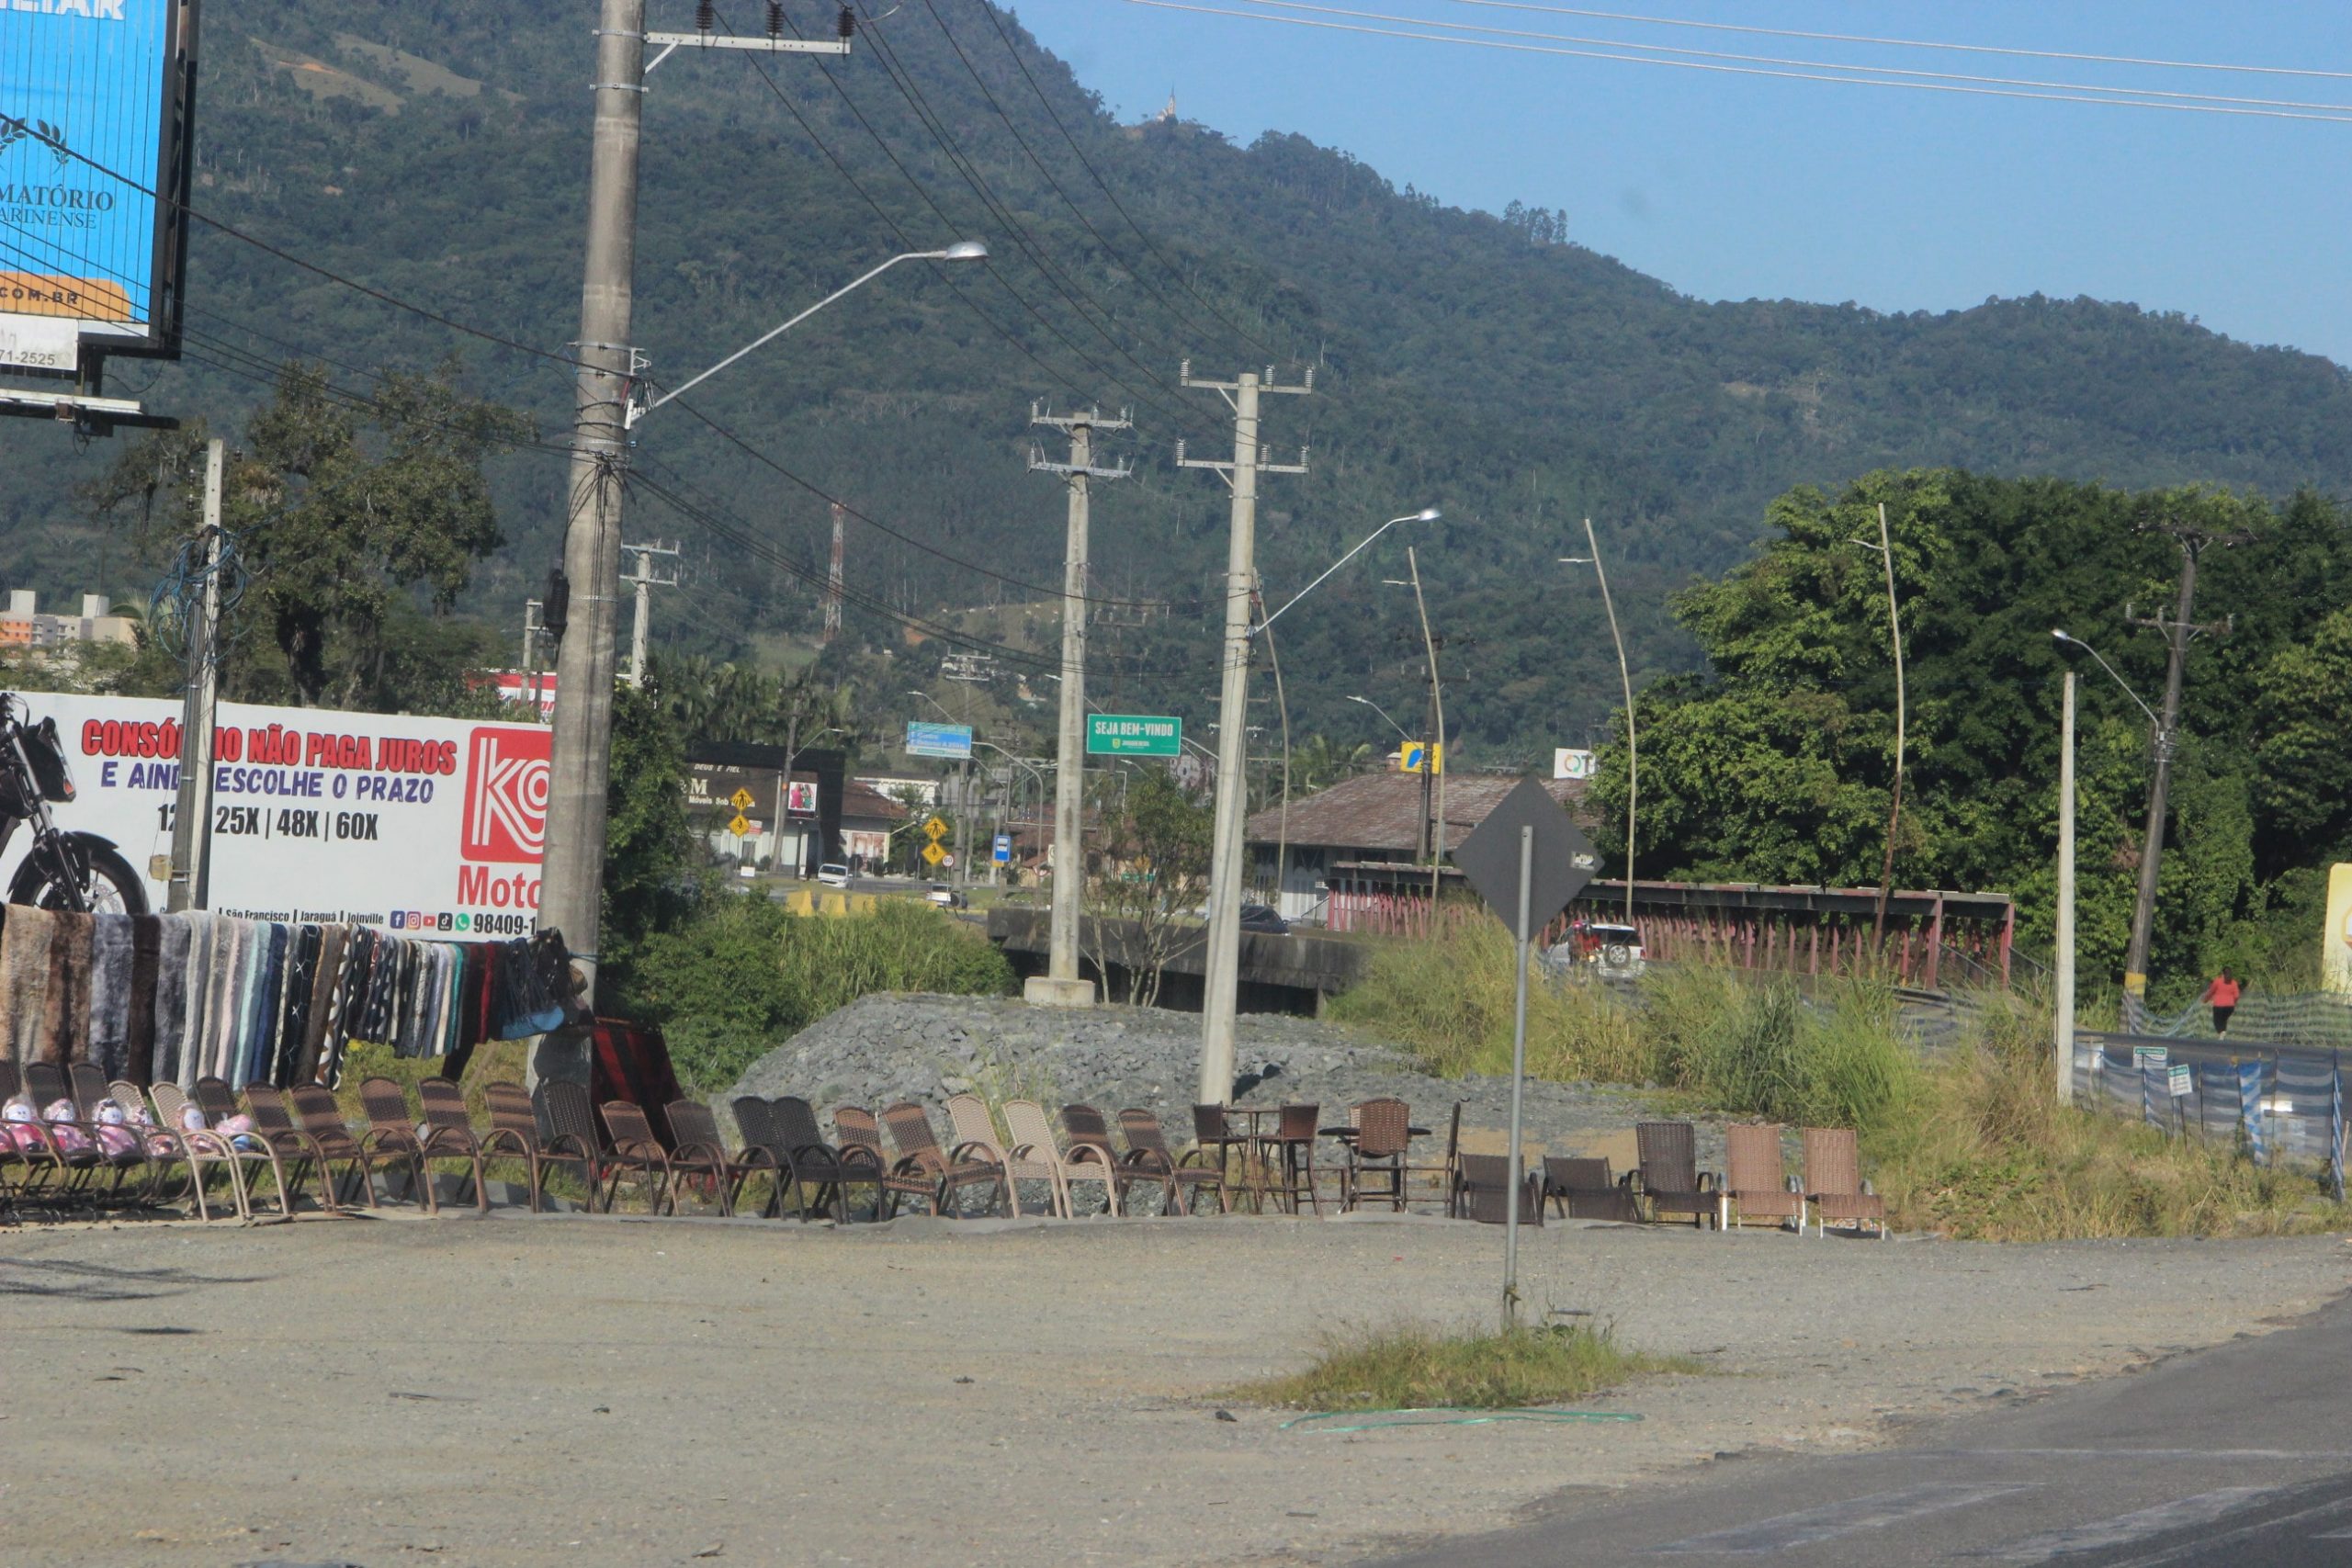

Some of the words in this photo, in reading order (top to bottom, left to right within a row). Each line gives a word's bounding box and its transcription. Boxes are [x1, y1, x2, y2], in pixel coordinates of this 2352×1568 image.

[82, 716, 243, 761] CONSÓIO
[247, 723, 301, 766] NÃO
[305, 732, 372, 770] PAGA
[375, 737, 458, 776] JUROS
[1095, 721, 1118, 735] SEJA
[1120, 722, 1173, 737] BEM-VINDO
[101, 761, 119, 787] E
[128, 763, 181, 791] AIND
[215, 767, 324, 797] ESCOLHE
[332, 773, 347, 799] O
[356, 775, 434, 804] PRAZO
[214, 806, 259, 835] 25X
[277, 809, 319, 838] 48X
[335, 812, 379, 840] 60X
[244, 909, 289, 922] Francisco
[300, 912, 336, 924] Jaraguá
[347, 915, 384, 925] Joinville
